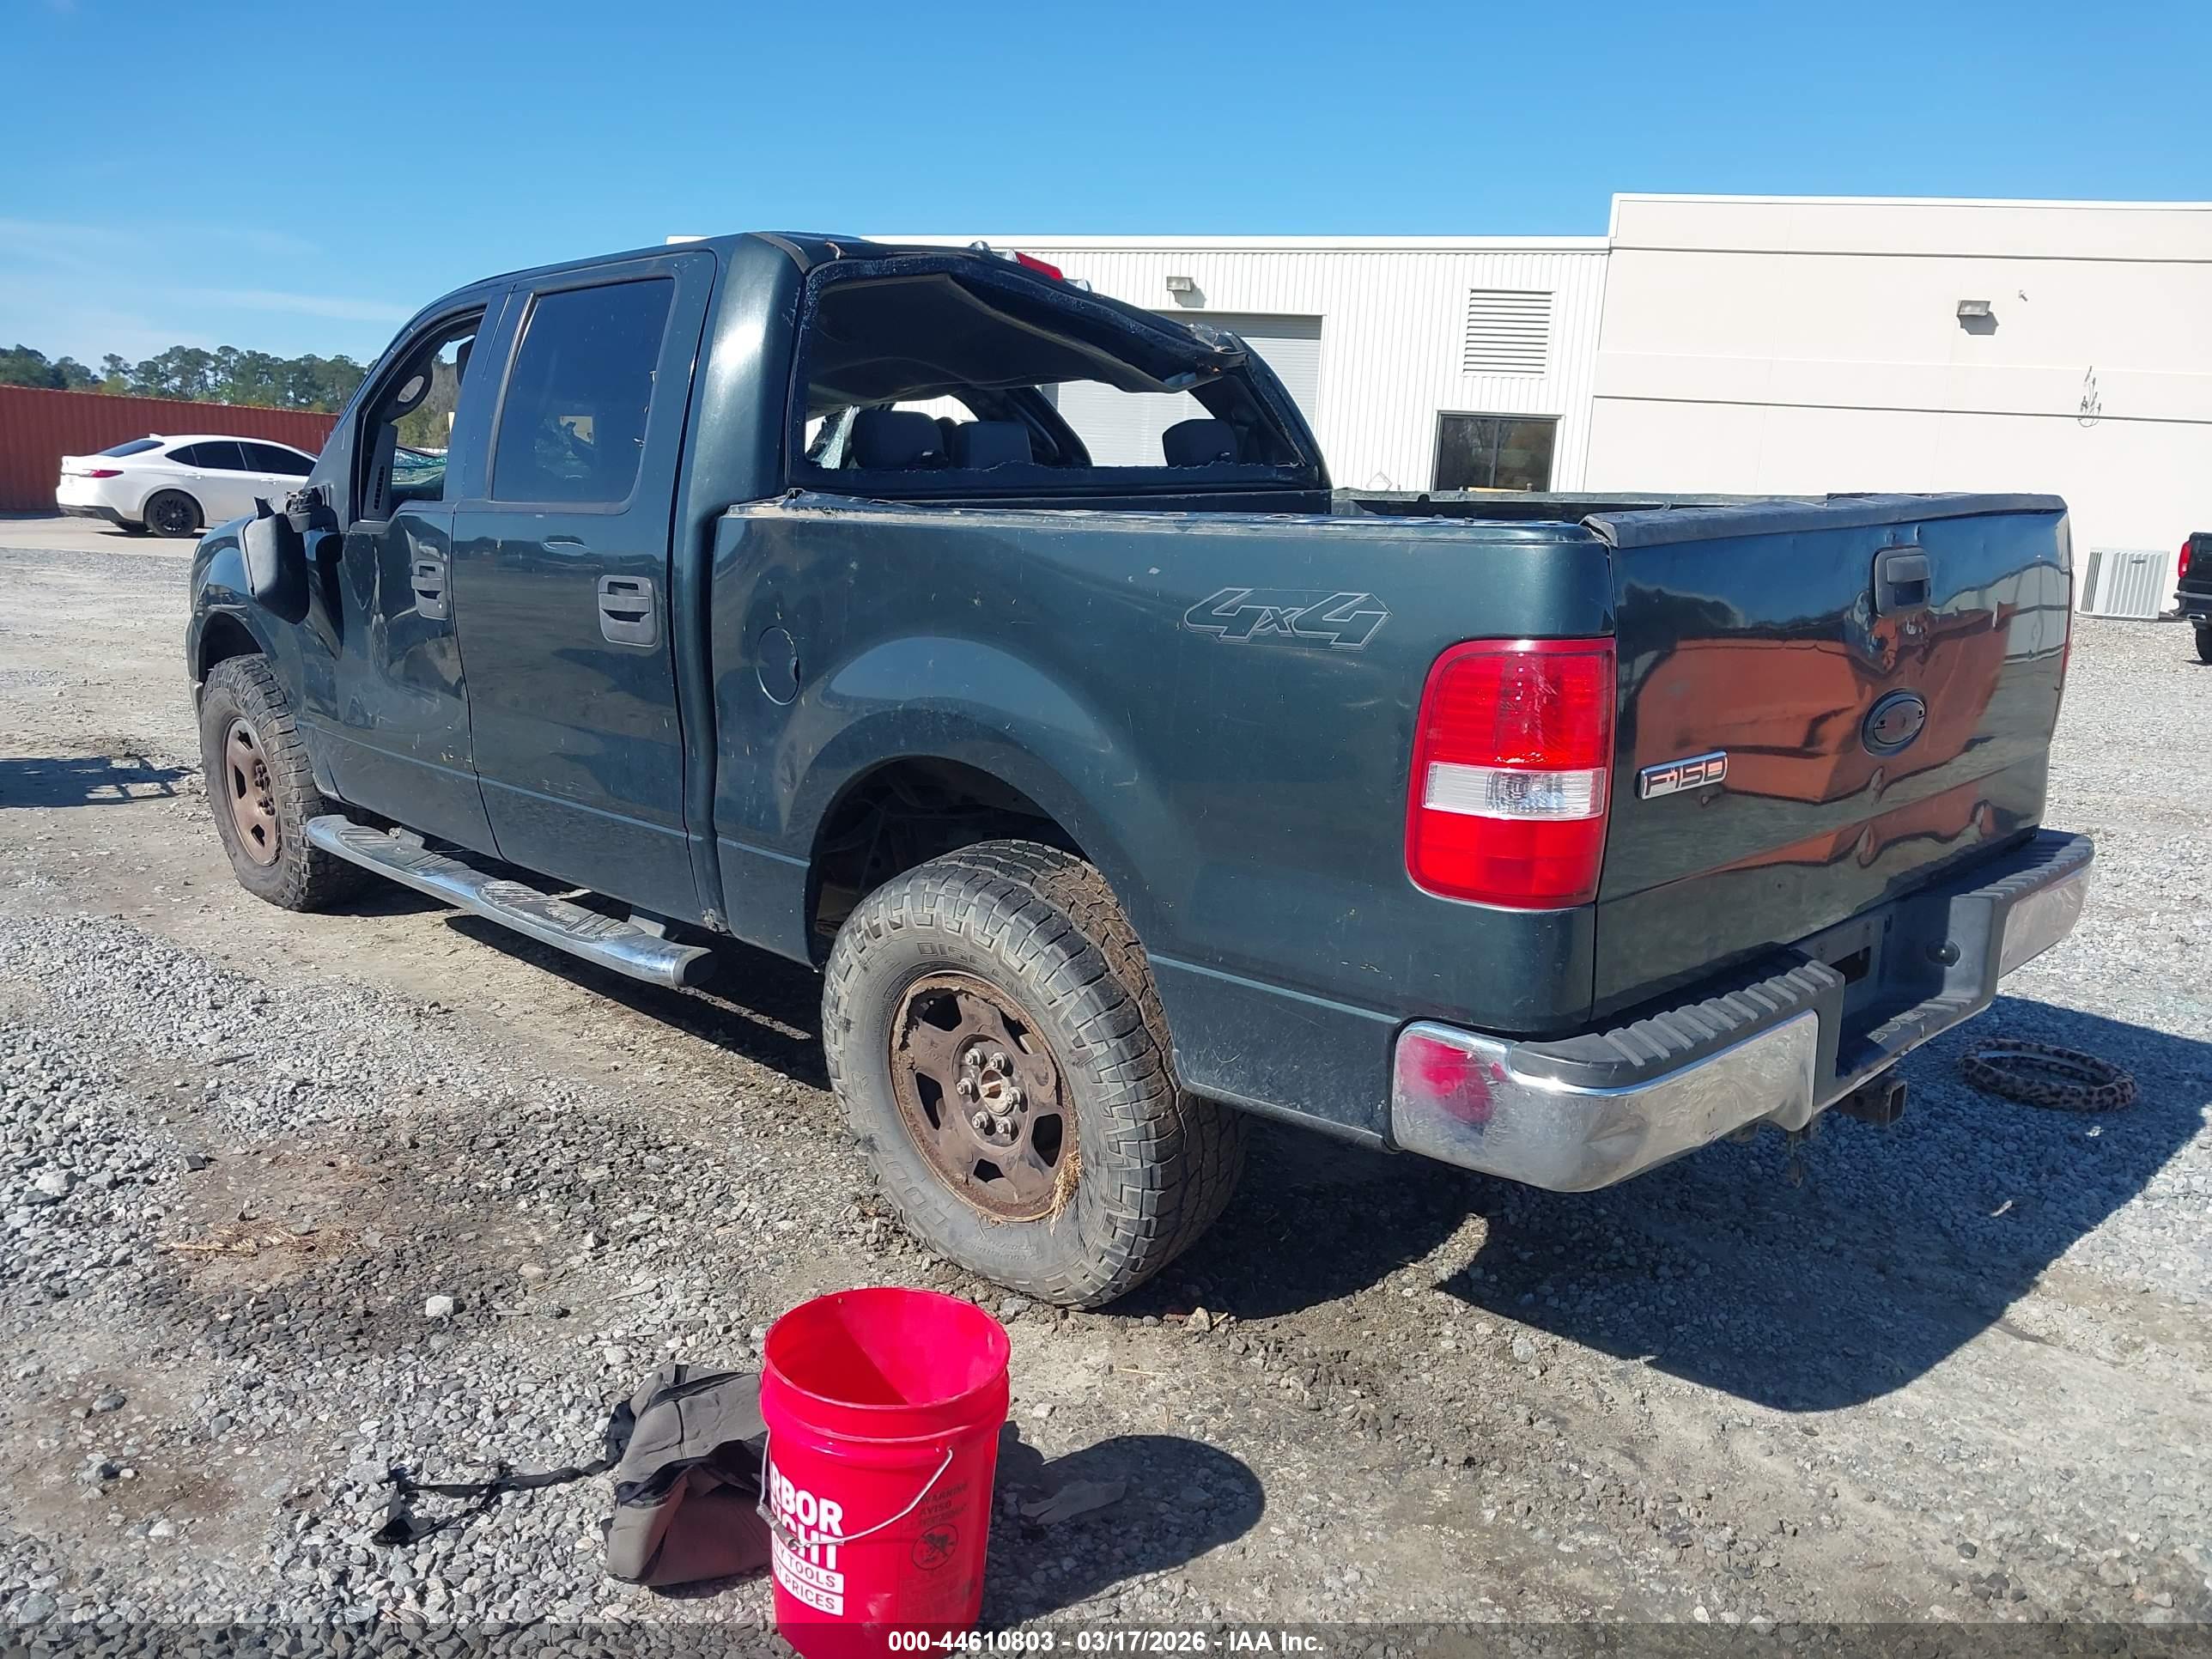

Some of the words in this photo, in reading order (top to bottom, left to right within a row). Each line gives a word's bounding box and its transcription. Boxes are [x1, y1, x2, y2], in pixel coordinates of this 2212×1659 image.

[771, 1461, 843, 1537] RBOR
[787, 1553, 836, 1588] TOOLS
[785, 1573, 835, 1609] PRICES
